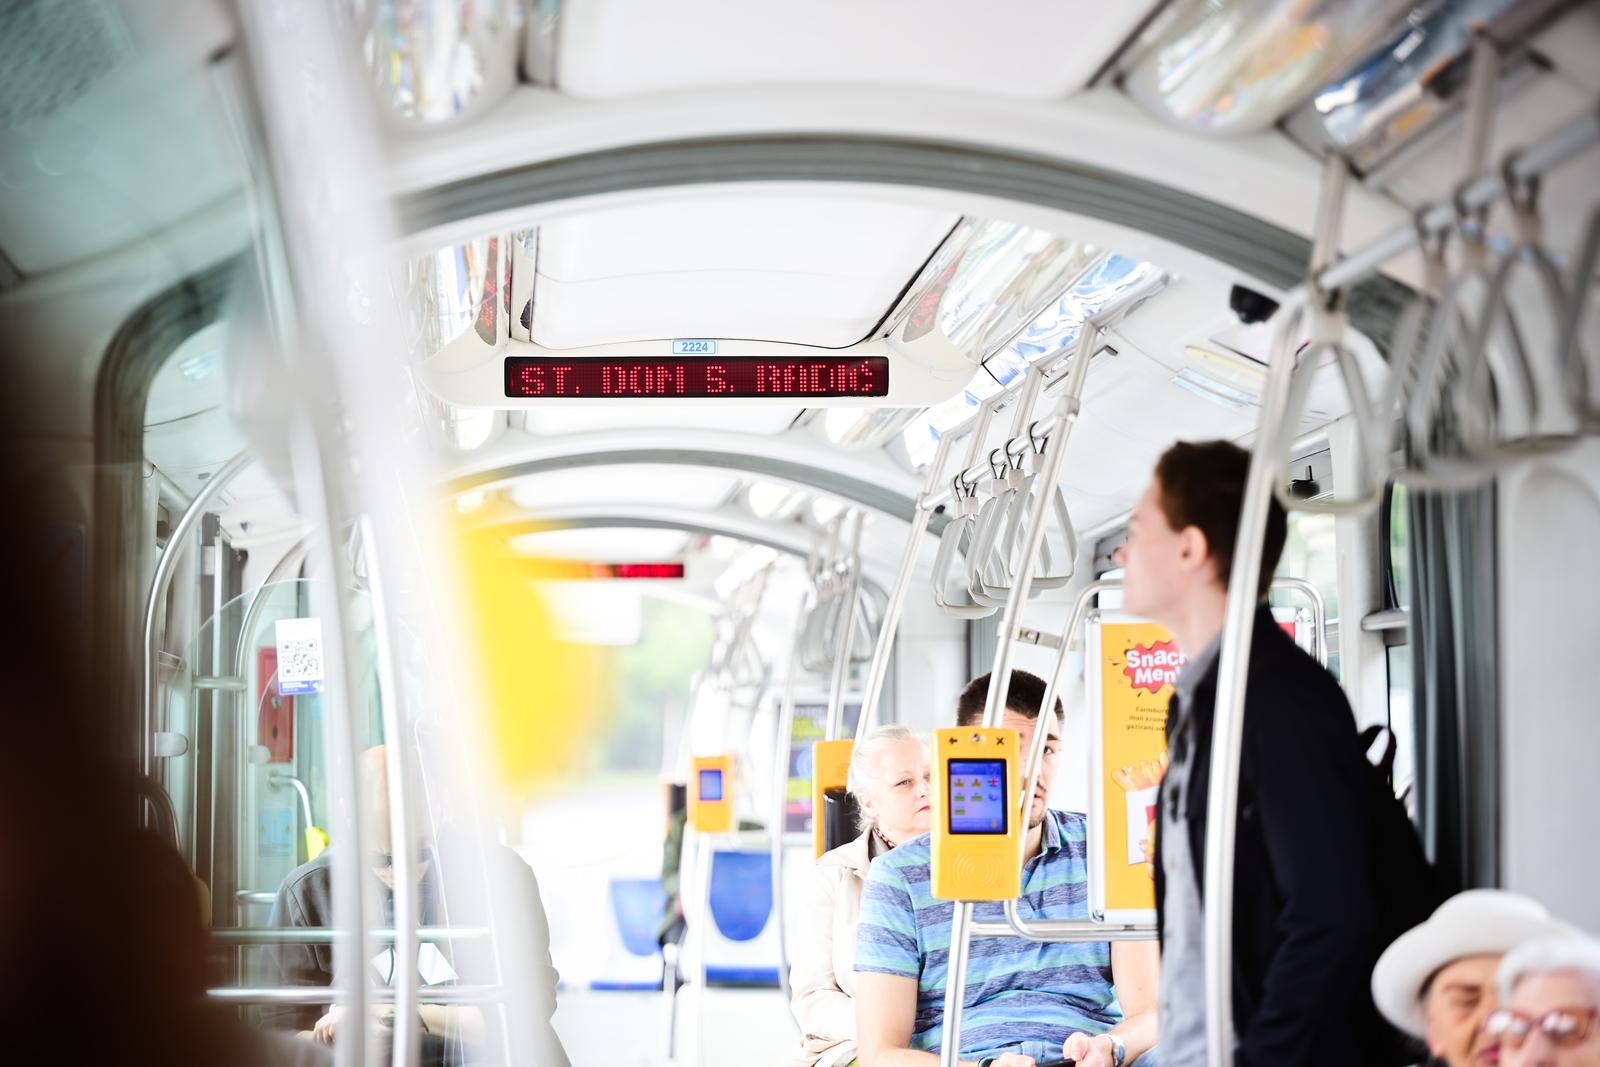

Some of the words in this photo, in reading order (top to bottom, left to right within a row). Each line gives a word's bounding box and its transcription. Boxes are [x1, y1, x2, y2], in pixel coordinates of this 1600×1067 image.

[681, 341, 709, 353] 2224
[520, 366, 581, 395] ST.
[706, 365, 736, 393] S.
[1134, 666, 1181, 685] Men
